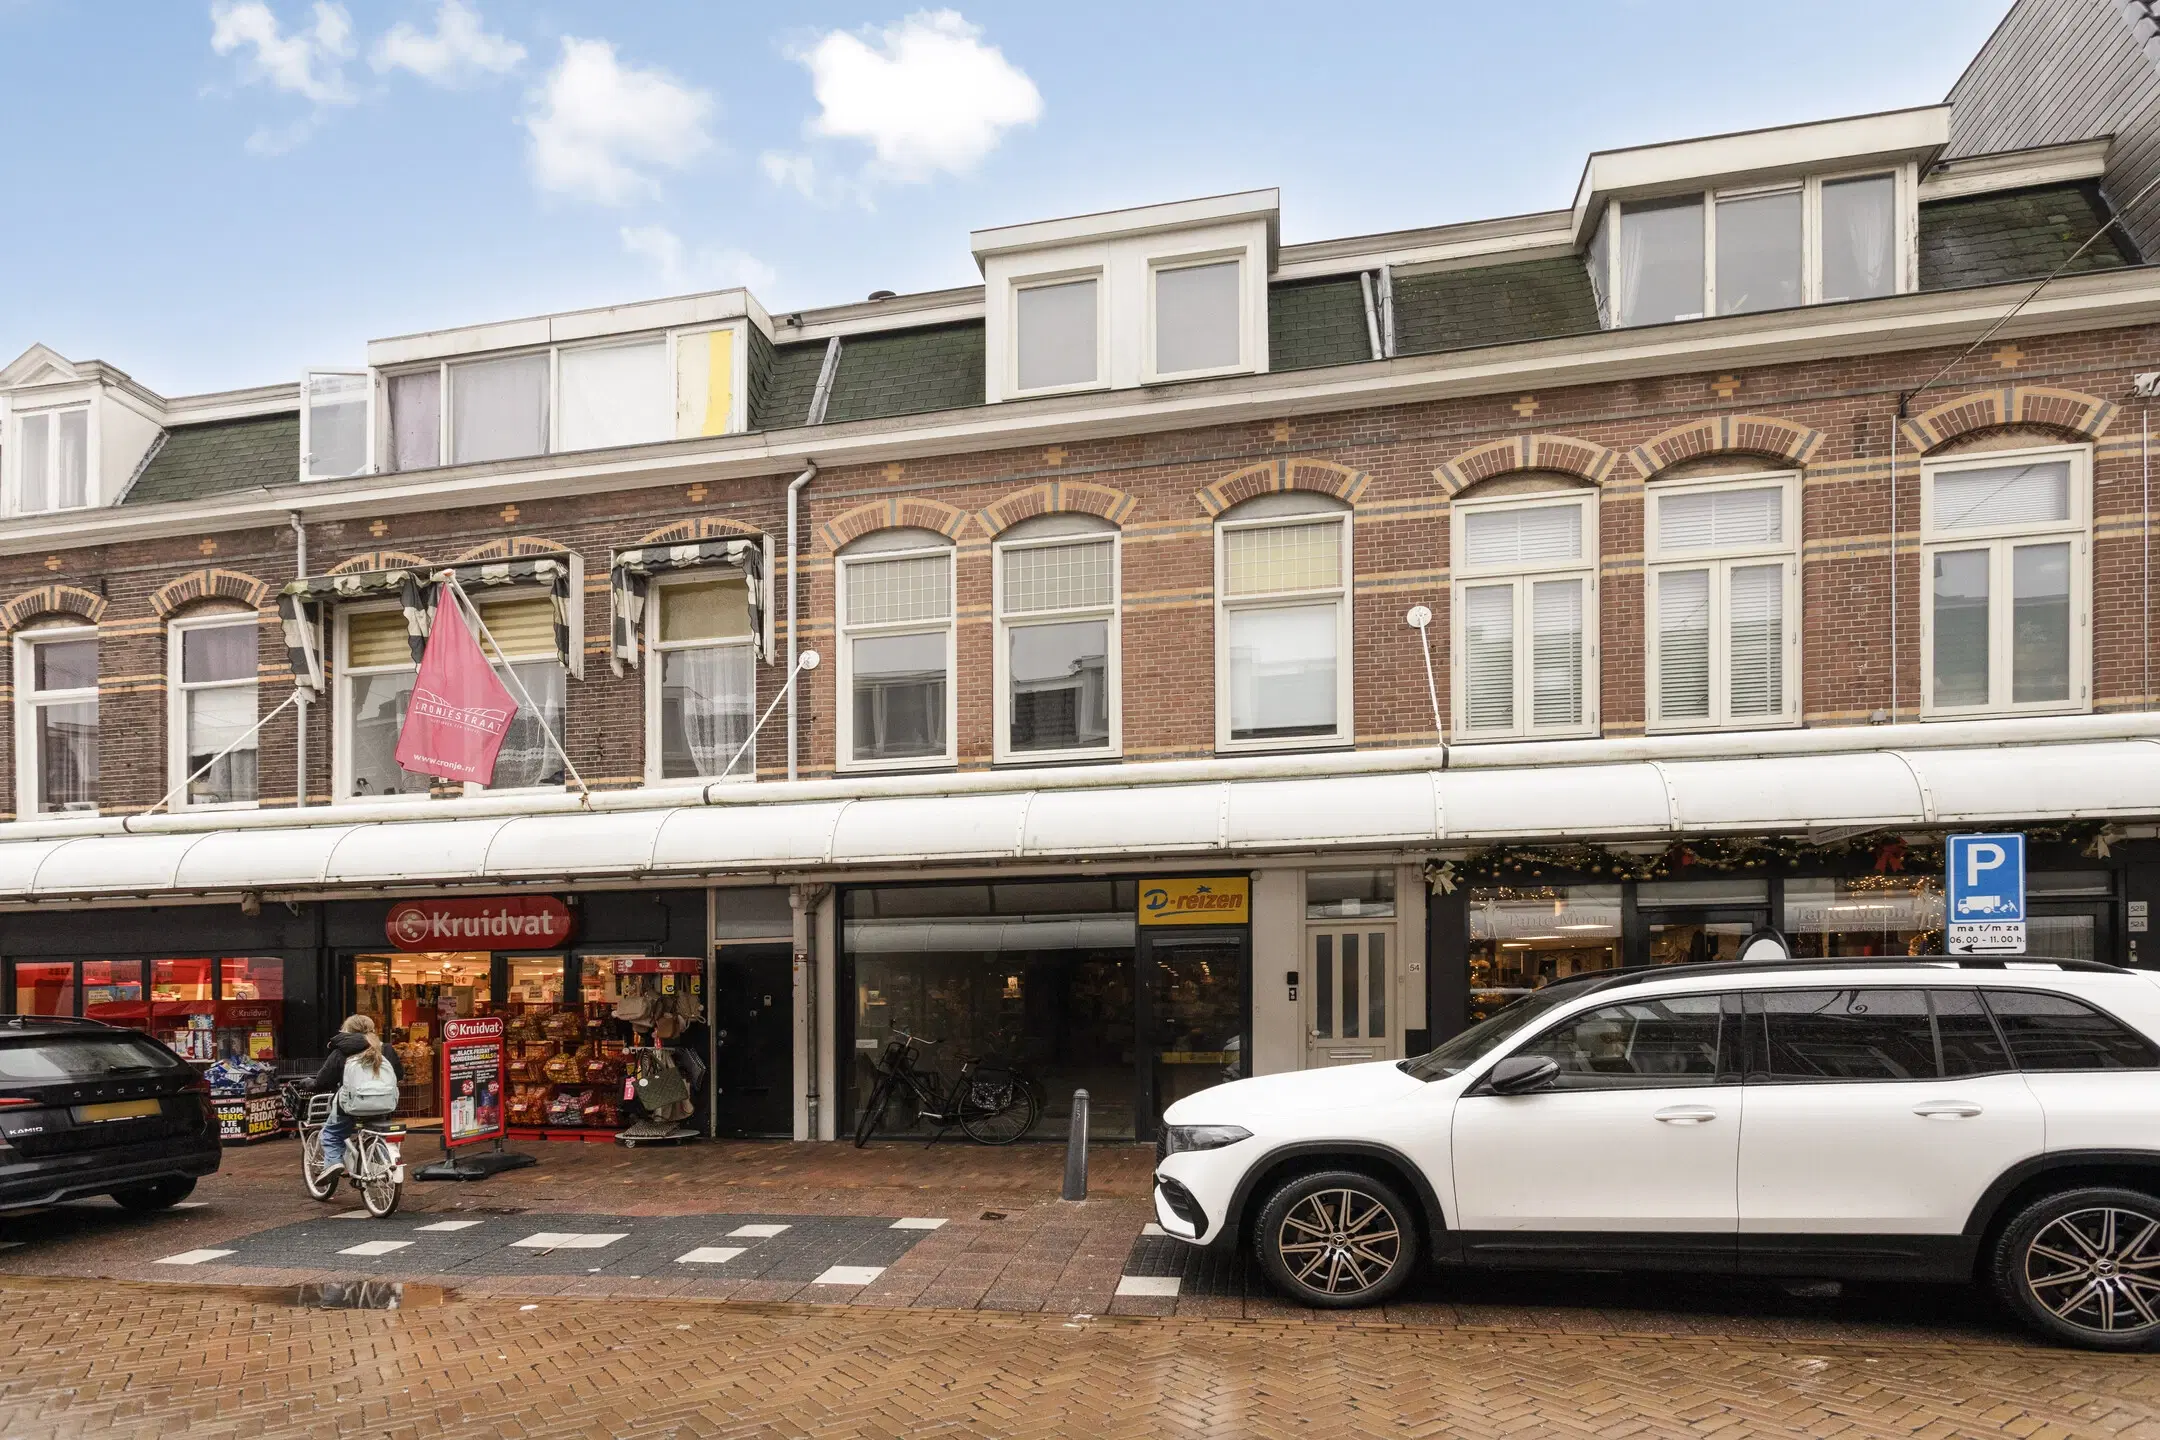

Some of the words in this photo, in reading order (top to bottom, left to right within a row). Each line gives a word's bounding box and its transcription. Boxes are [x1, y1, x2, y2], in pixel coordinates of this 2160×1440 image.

[413, 754, 476, 773] www.cronje.nl
[1967, 843, 2006, 887] P
[1144, 888, 1243, 910] D-reizen
[2130, 904, 2145, 913] 52B
[433, 909, 554, 938] Kruidvat
[1507, 913, 1553, 927] Tante
[1560, 914, 1608, 925] Moon
[2130, 920, 2146, 928] 52A
[1979, 924, 2002, 932] t/m
[1950, 936, 1979, 944] 06.00
[1410, 964, 1420, 972] 54
[460, 1021, 499, 1035] Kruidvat
[250, 1100, 276, 1112] BLACK
[249, 1109, 277, 1123] FRIDAY
[9, 1126, 43, 1135] KAMIQ
[248, 1120, 273, 1133] DEALS
